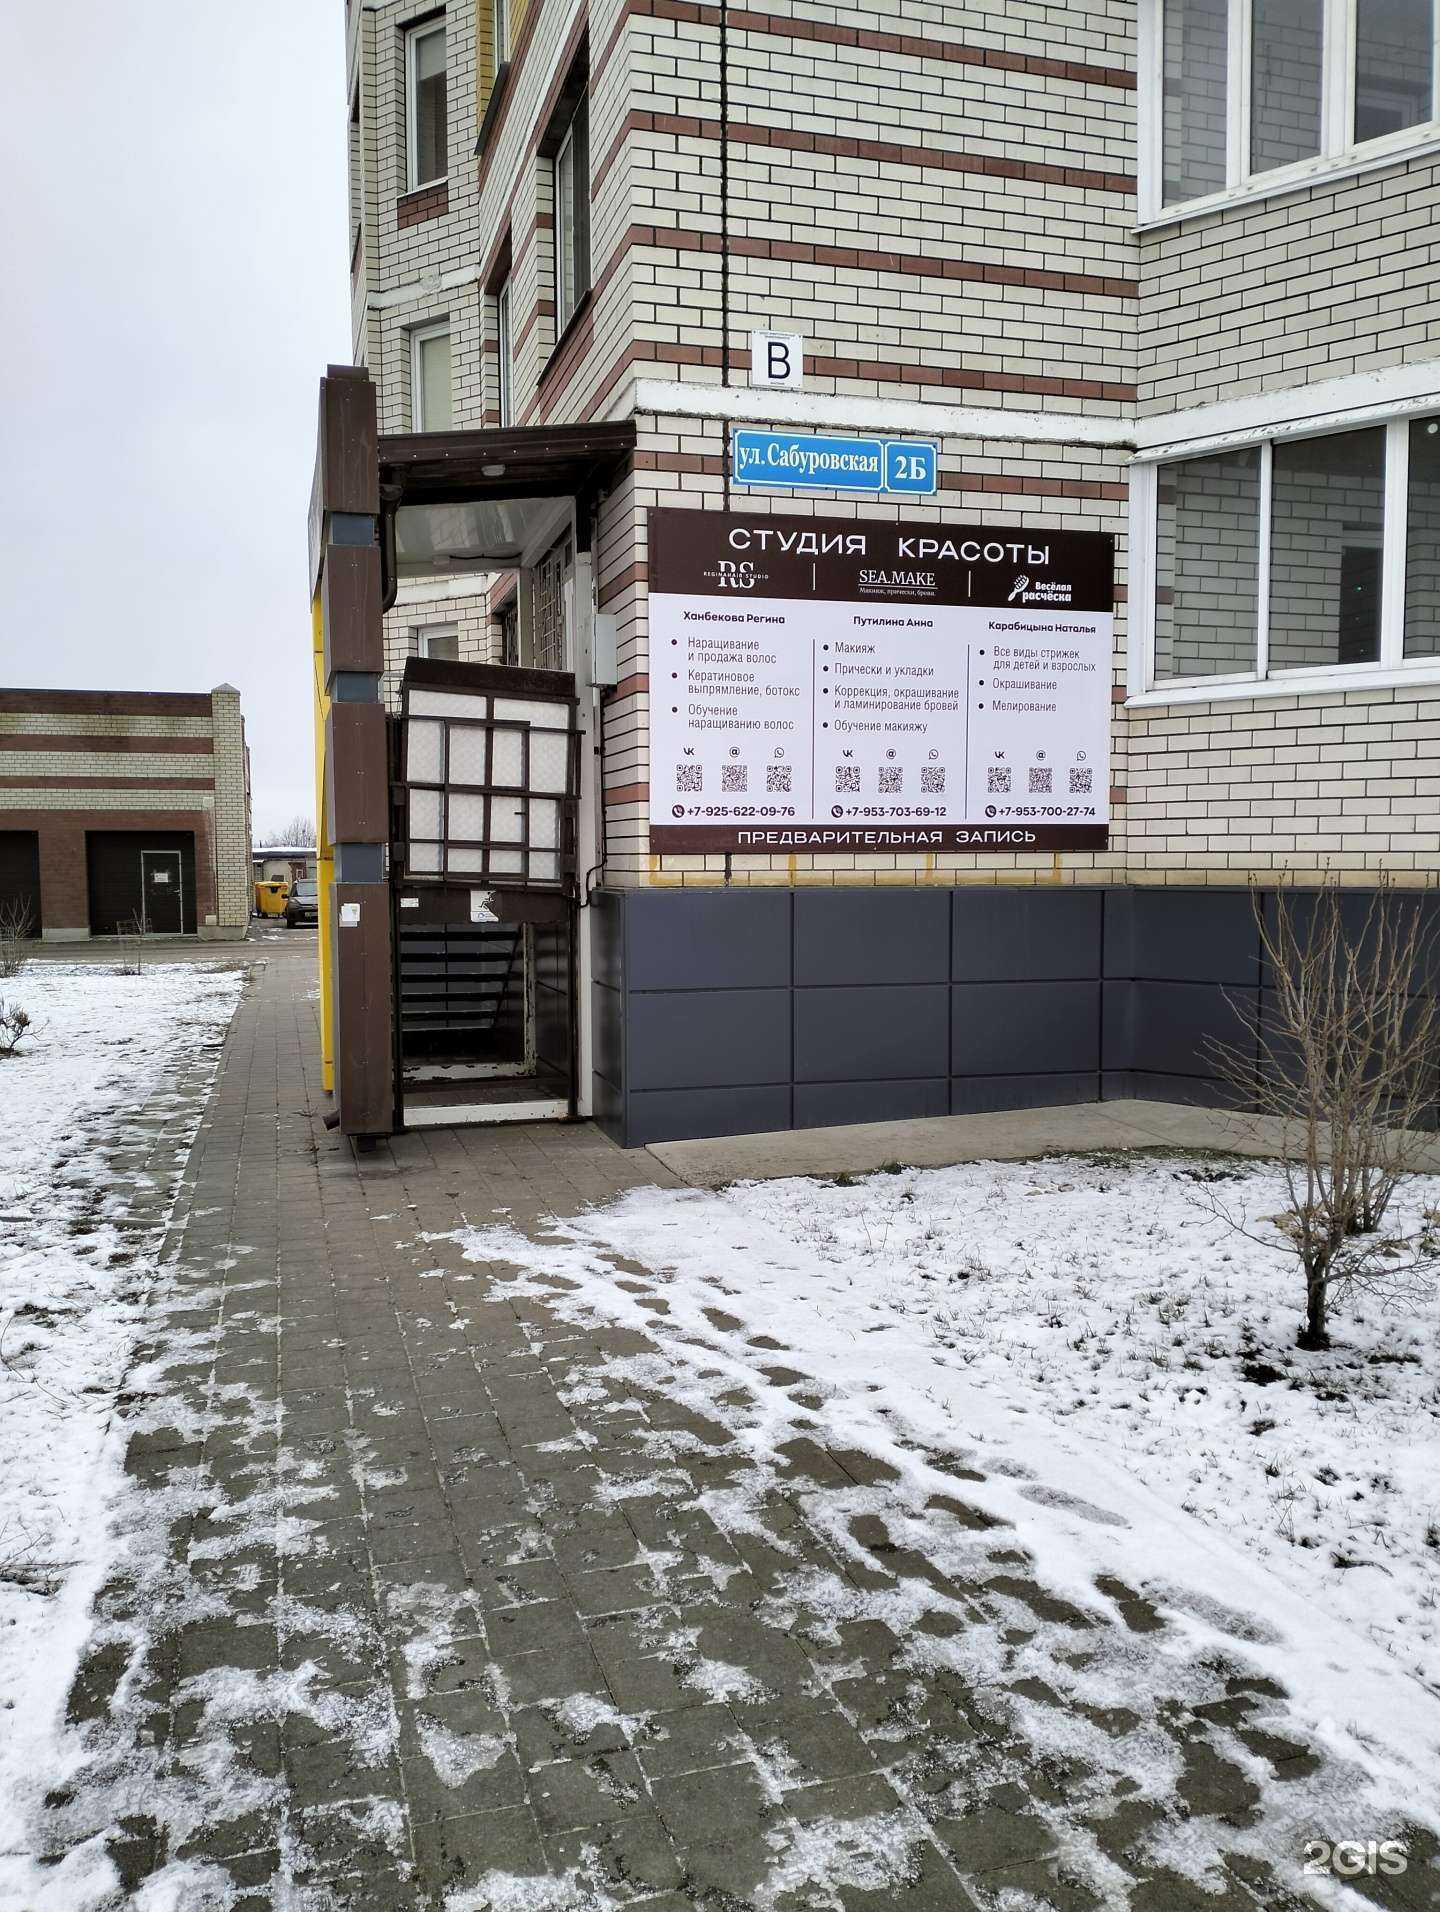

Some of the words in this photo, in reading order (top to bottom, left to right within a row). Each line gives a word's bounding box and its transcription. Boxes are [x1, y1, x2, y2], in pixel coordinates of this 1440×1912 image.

[894, 455, 926, 480] 2Б
[728, 528, 866, 556] СТУДИЯ
[898, 537, 1049, 565] КРАСОТЫ
[859, 569, 936, 586] SEA.MAKE
[1035, 581, 1072, 591] Весёлая
[1022, 590, 1072, 603] расчёска
[683, 611, 744, 623] Ханбекова
[746, 613, 785, 624] Регина
[853, 616, 904, 628] Путилина
[906, 617, 933, 628] Анна
[988, 621, 1053, 632] Карабицына
[1055, 624, 1096, 634] Наталья
[688, 636, 760, 650] Наращивание
[835, 642, 876, 654] Макияж
[688, 652, 694, 661] и
[697, 652, 743, 664] продажа
[746, 654, 777, 664] волос
[993, 645, 1011, 657] Все
[1013, 647, 1038, 659] виды
[1040, 648, 1080, 660] стрижек
[834, 662, 883, 676] Прически
[885, 666, 892, 675] и
[894, 666, 934, 678] укладки
[993, 660, 1011, 670] для
[1013, 660, 1040, 671] детей
[1042, 662, 1049, 670] и
[1051, 661, 1096, 673] взрослых
[688, 669, 755, 683] Кератиновое
[992, 677, 1058, 691] Окрашивание
[688, 684, 762, 698] выпрямление,
[765, 685, 801, 697] ботокс
[834, 685, 891, 698] Коррекция,
[893, 687, 959, 699] окрашивание
[688, 704, 738, 717] Обучение
[834, 700, 840, 709] и
[843, 700, 921, 712] ламинирование
[924, 700, 959, 713] бровей
[992, 700, 1057, 713] Мелирование
[688, 719, 761, 731] наращиванию
[764, 721, 795, 731] волос
[834, 719, 882, 732] Обучение
[884, 722, 928, 734] макияжу
[687, 806, 796, 817] +7-925-622-09-76
[845, 806, 947, 817] +7-953-703-69-12
[998, 806, 1096, 817] +7-953-700-27-74
[738, 831, 943, 845] ПРЕДВАРИТЕЛЬНАЯ
[955, 830, 1036, 843] ЗАПИСЬ
